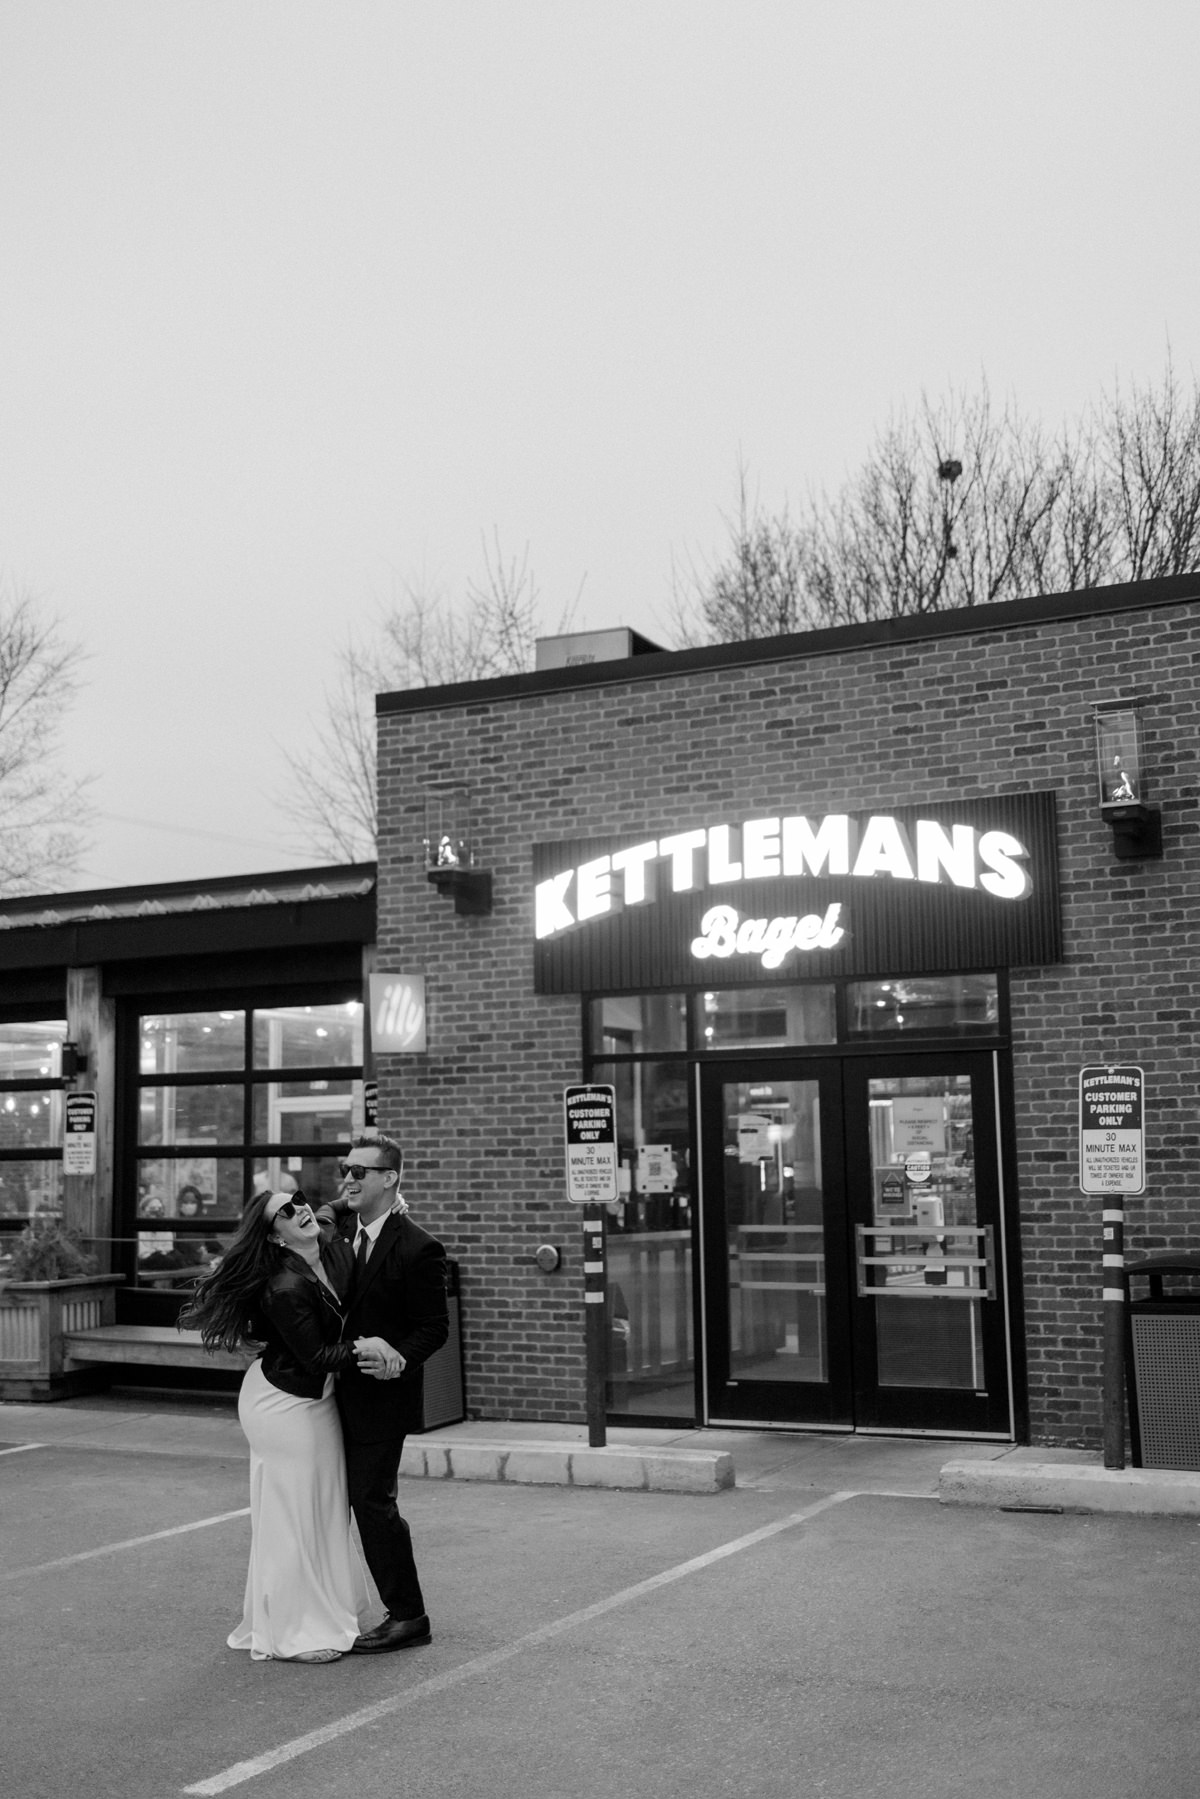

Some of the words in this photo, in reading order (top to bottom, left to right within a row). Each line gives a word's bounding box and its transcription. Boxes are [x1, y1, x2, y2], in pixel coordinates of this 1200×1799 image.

[535, 814, 1030, 939] KETTLEMANS
[691, 902, 847, 969] Bagel
[376, 983, 424, 1047] illy
[1083, 1075, 1140, 1089] KETTLEMAN'S
[1085, 1091, 1138, 1102] CUSTOMER
[569, 1108, 611, 1118] CUSTOMER
[1090, 1103, 1133, 1114] PARKING
[573, 1119, 607, 1129] PARKING
[1098, 1116, 1123, 1126] ONLY
[580, 1130, 600, 1140] ONLY
[1105, 1132, 1117, 1141] 30
[1085, 1143, 1115, 1153] MINUTE
[1118, 1143, 1137, 1153] MAX
[571, 1157, 594, 1166] MINUTE
[597, 1156, 611, 1165] MAX
